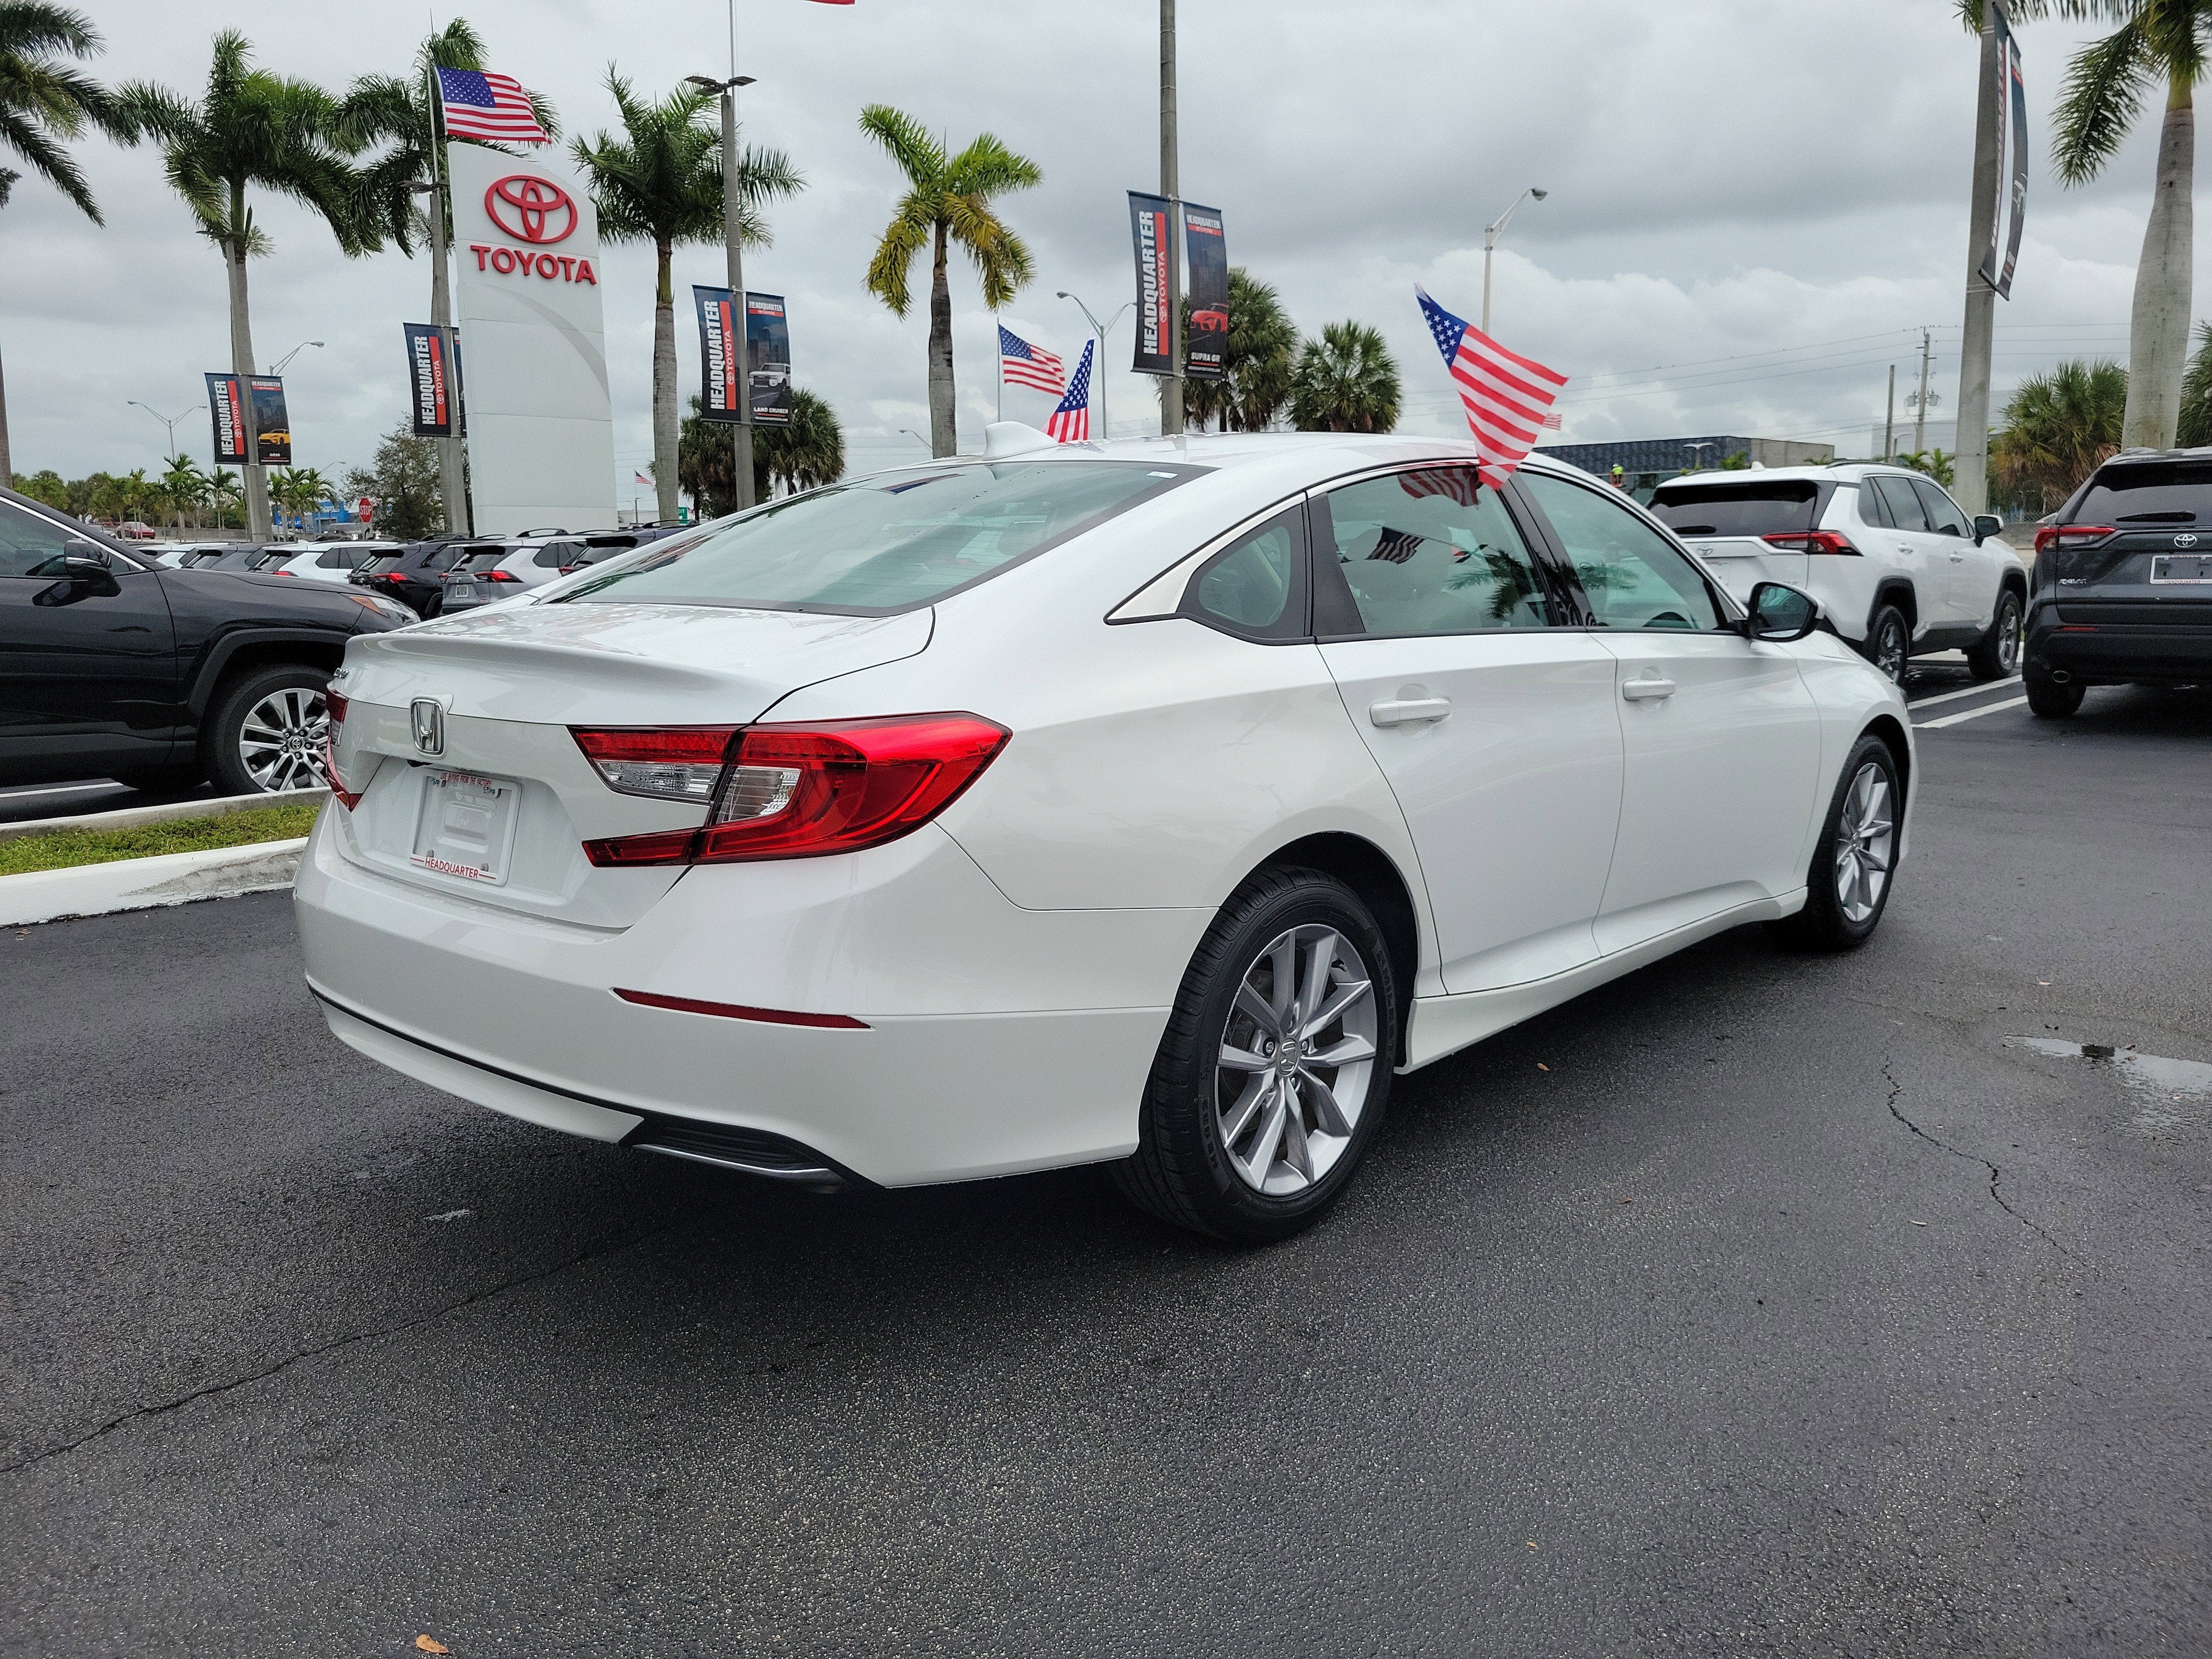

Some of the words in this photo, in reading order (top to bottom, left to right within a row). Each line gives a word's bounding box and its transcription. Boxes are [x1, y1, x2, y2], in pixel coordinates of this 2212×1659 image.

[470, 245, 597, 285] TOYOTA
[1139, 211, 1158, 354] HEADQUARTER
[1158, 252, 1167, 304] TOYOTA
[704, 301, 725, 410] HEADQUARTER
[724, 330, 734, 371] TOYOTA
[1191, 352, 1211, 362] SUPRA
[414, 336, 436, 425] HEADQUARTER
[433, 360, 443, 393] TOYOTA
[215, 381, 235, 455] HEADQUARTER
[232, 400, 241, 428] TOYOTA
[360, 505, 372, 515] STOP
[425, 857, 479, 879] HEADQUARTER
